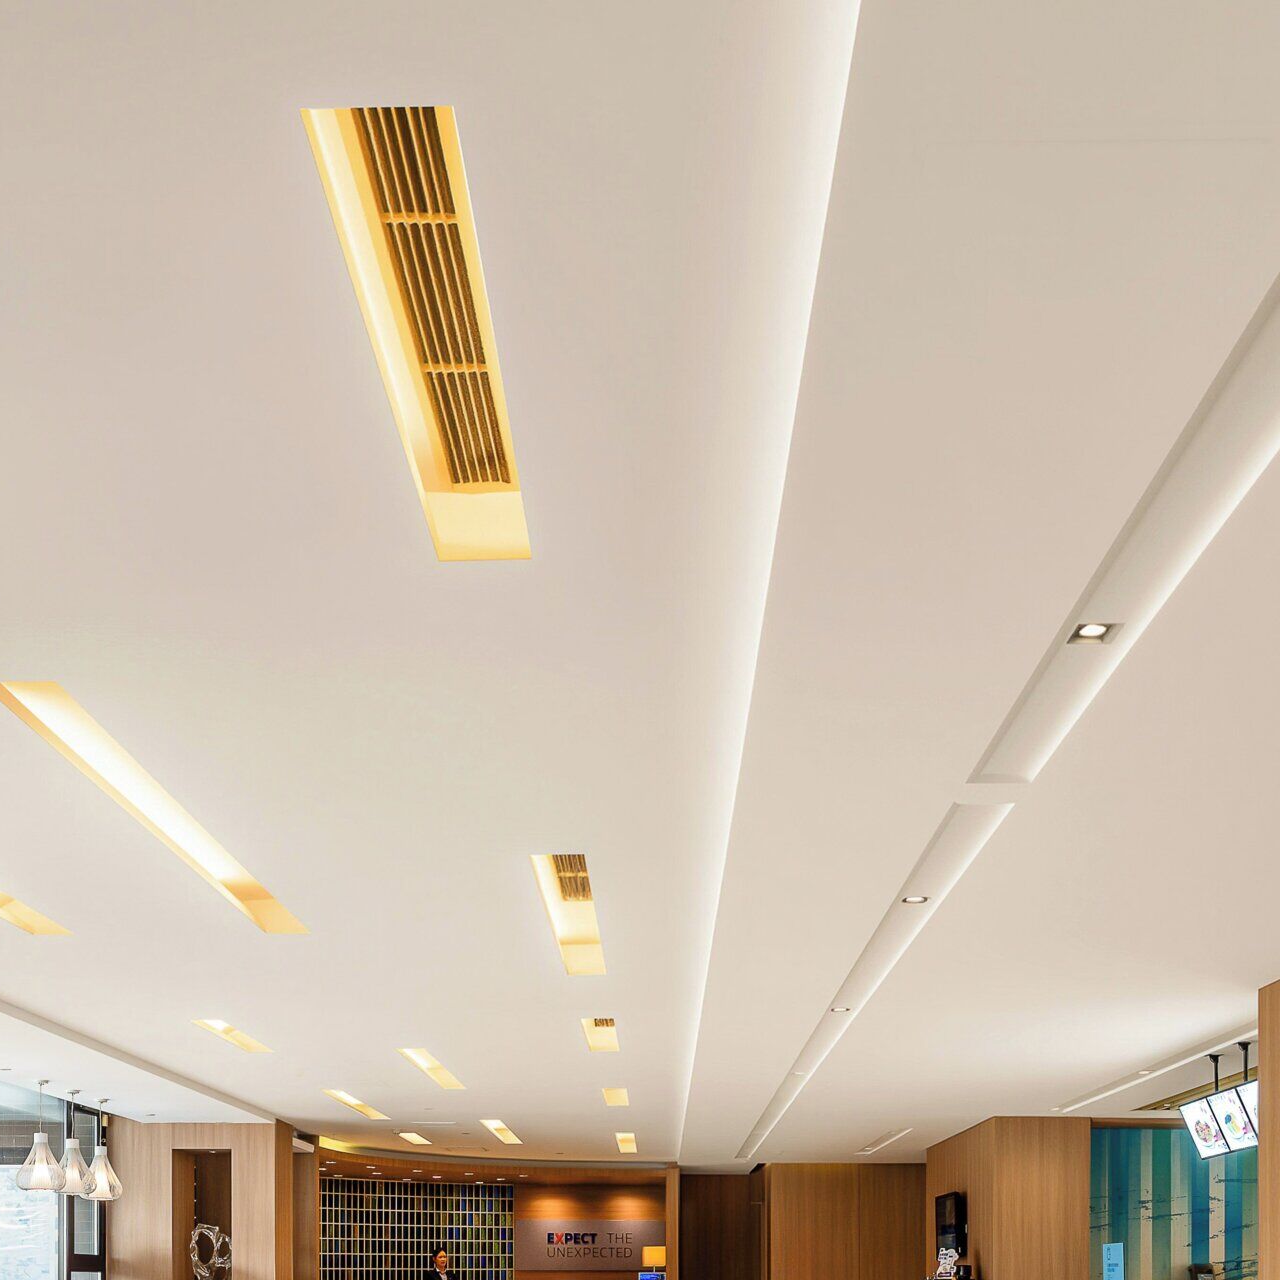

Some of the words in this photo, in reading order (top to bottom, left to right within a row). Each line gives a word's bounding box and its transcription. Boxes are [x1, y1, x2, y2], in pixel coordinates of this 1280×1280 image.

[547, 1232, 598, 1245] EXPECT
[607, 1232, 633, 1244] THE
[546, 1247, 633, 1258] UNEXPECTED
